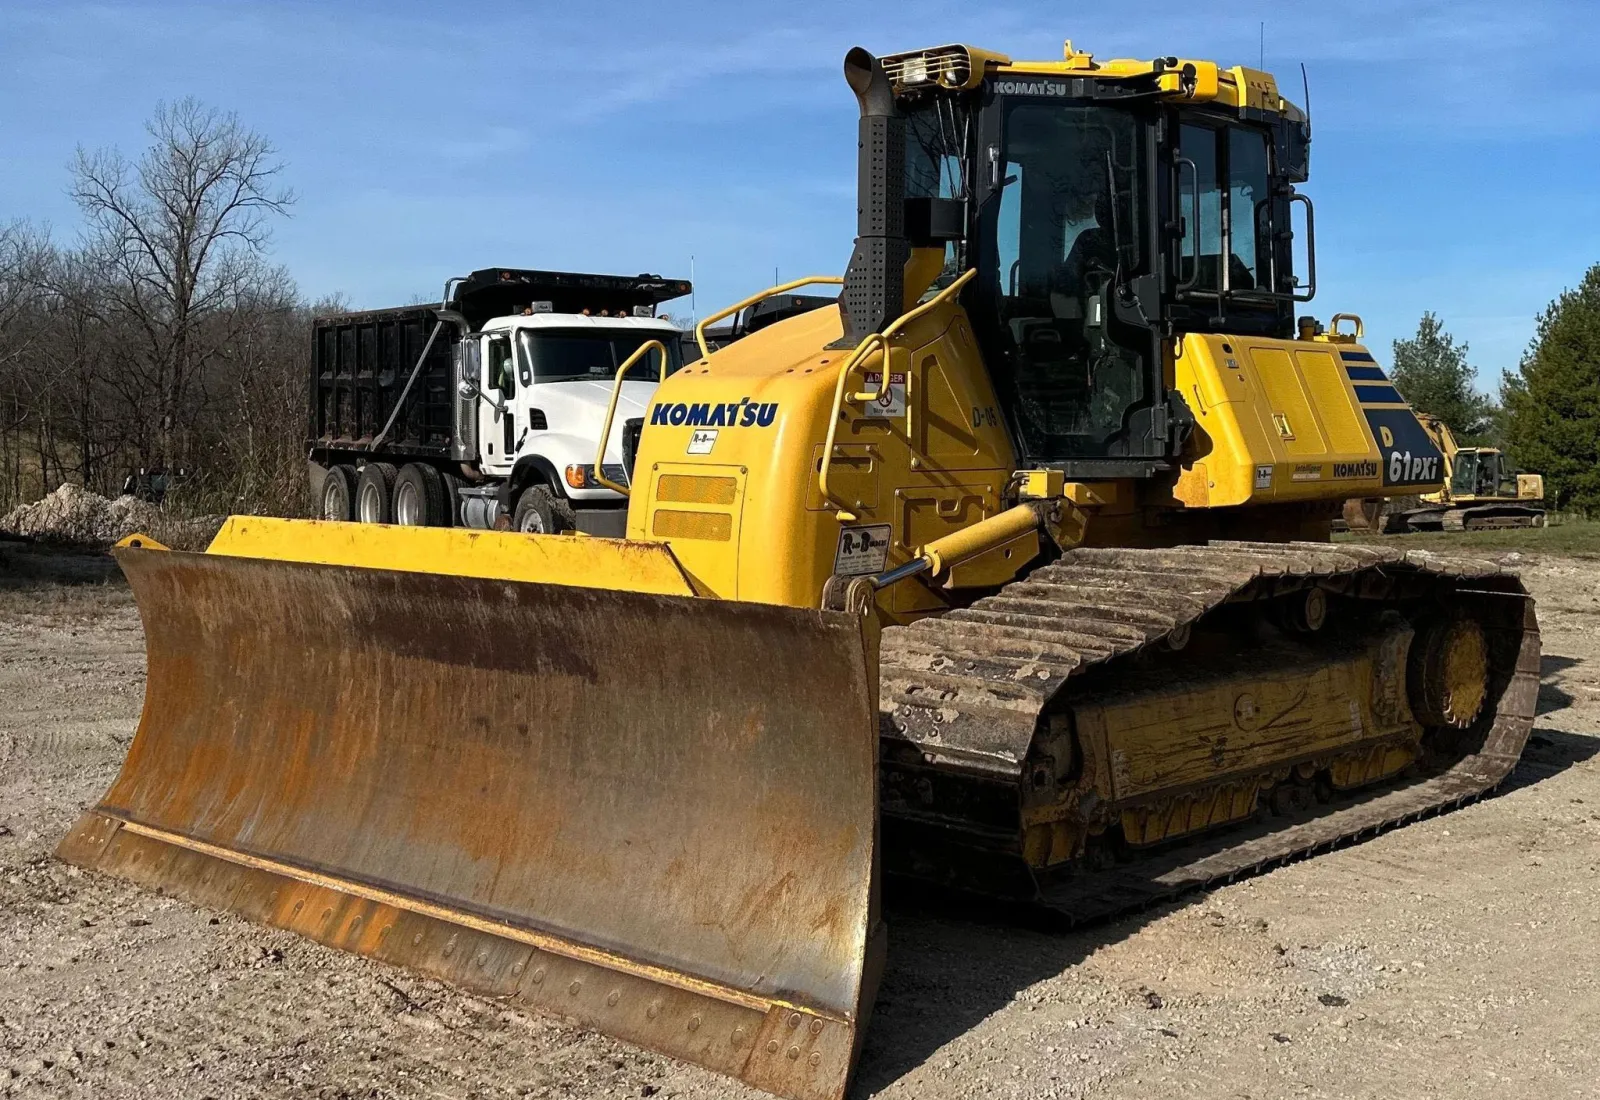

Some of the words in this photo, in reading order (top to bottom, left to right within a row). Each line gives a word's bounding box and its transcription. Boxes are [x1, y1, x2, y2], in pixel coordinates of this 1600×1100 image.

[993, 80, 1066, 95] KOMATSU
[650, 397, 779, 428] KOMATSU
[1379, 426, 1393, 447] D
[1333, 459, 1377, 477] KOMATSU
